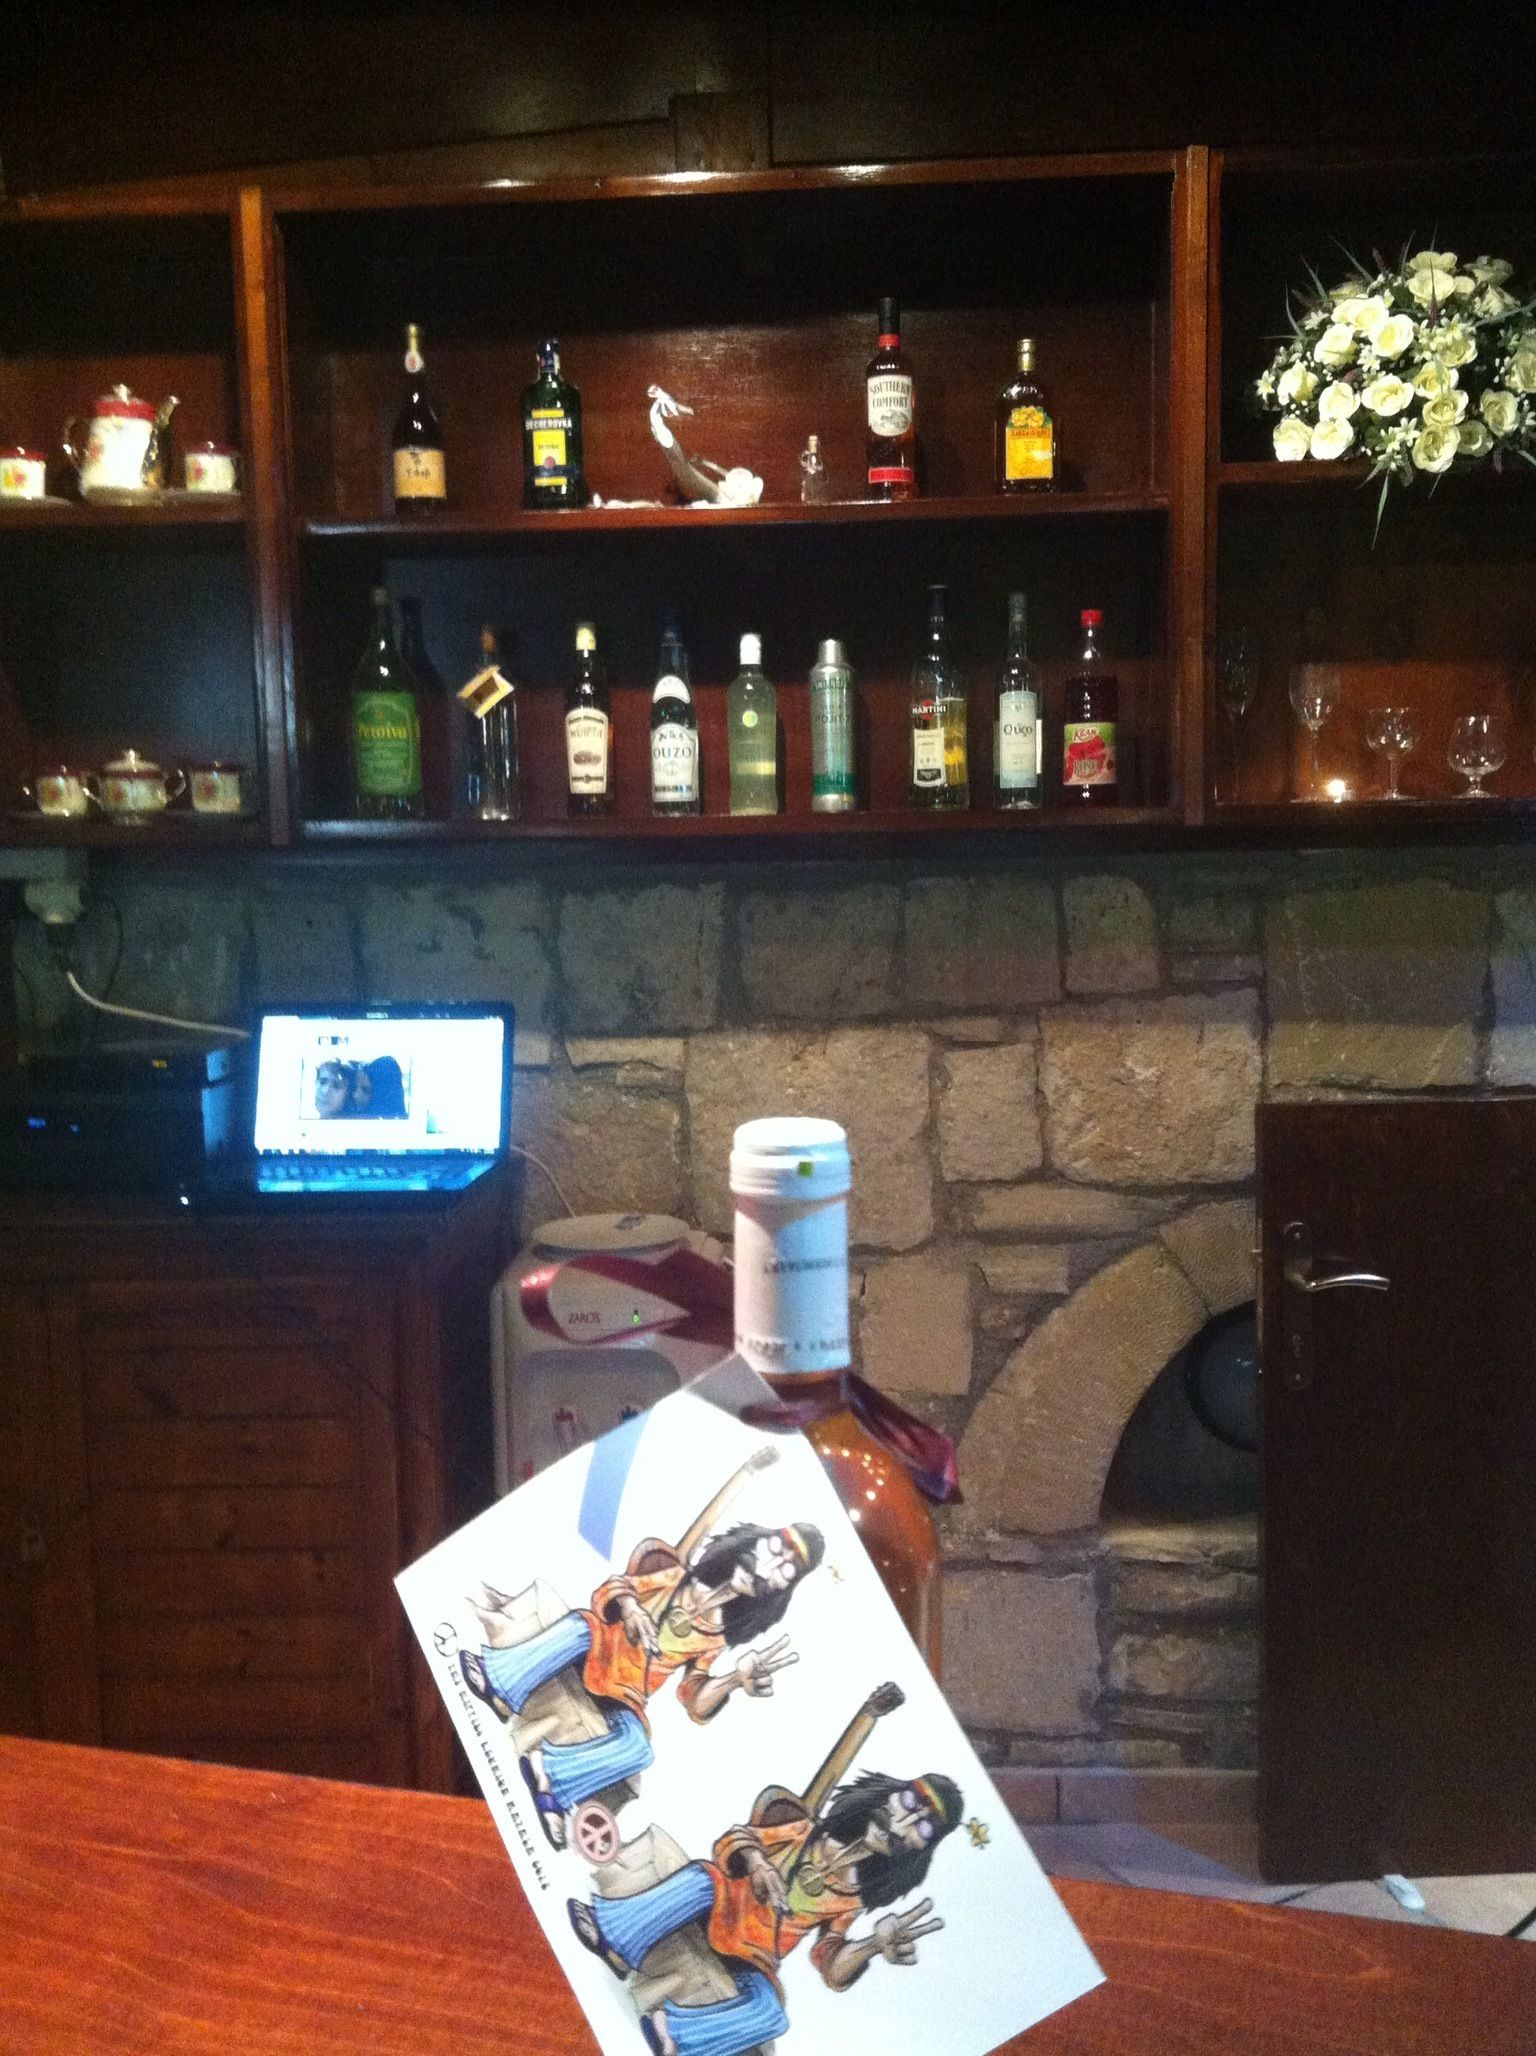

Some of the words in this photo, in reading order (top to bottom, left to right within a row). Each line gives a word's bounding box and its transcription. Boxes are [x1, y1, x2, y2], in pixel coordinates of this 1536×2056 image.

[870, 381, 911, 395] SOUTHERN
[872, 396, 908, 408] COMFORT
[912, 706, 946, 714] MARTINI
[1073, 728, 1097, 741] KEAN
[653, 747, 692, 759] OUZO
